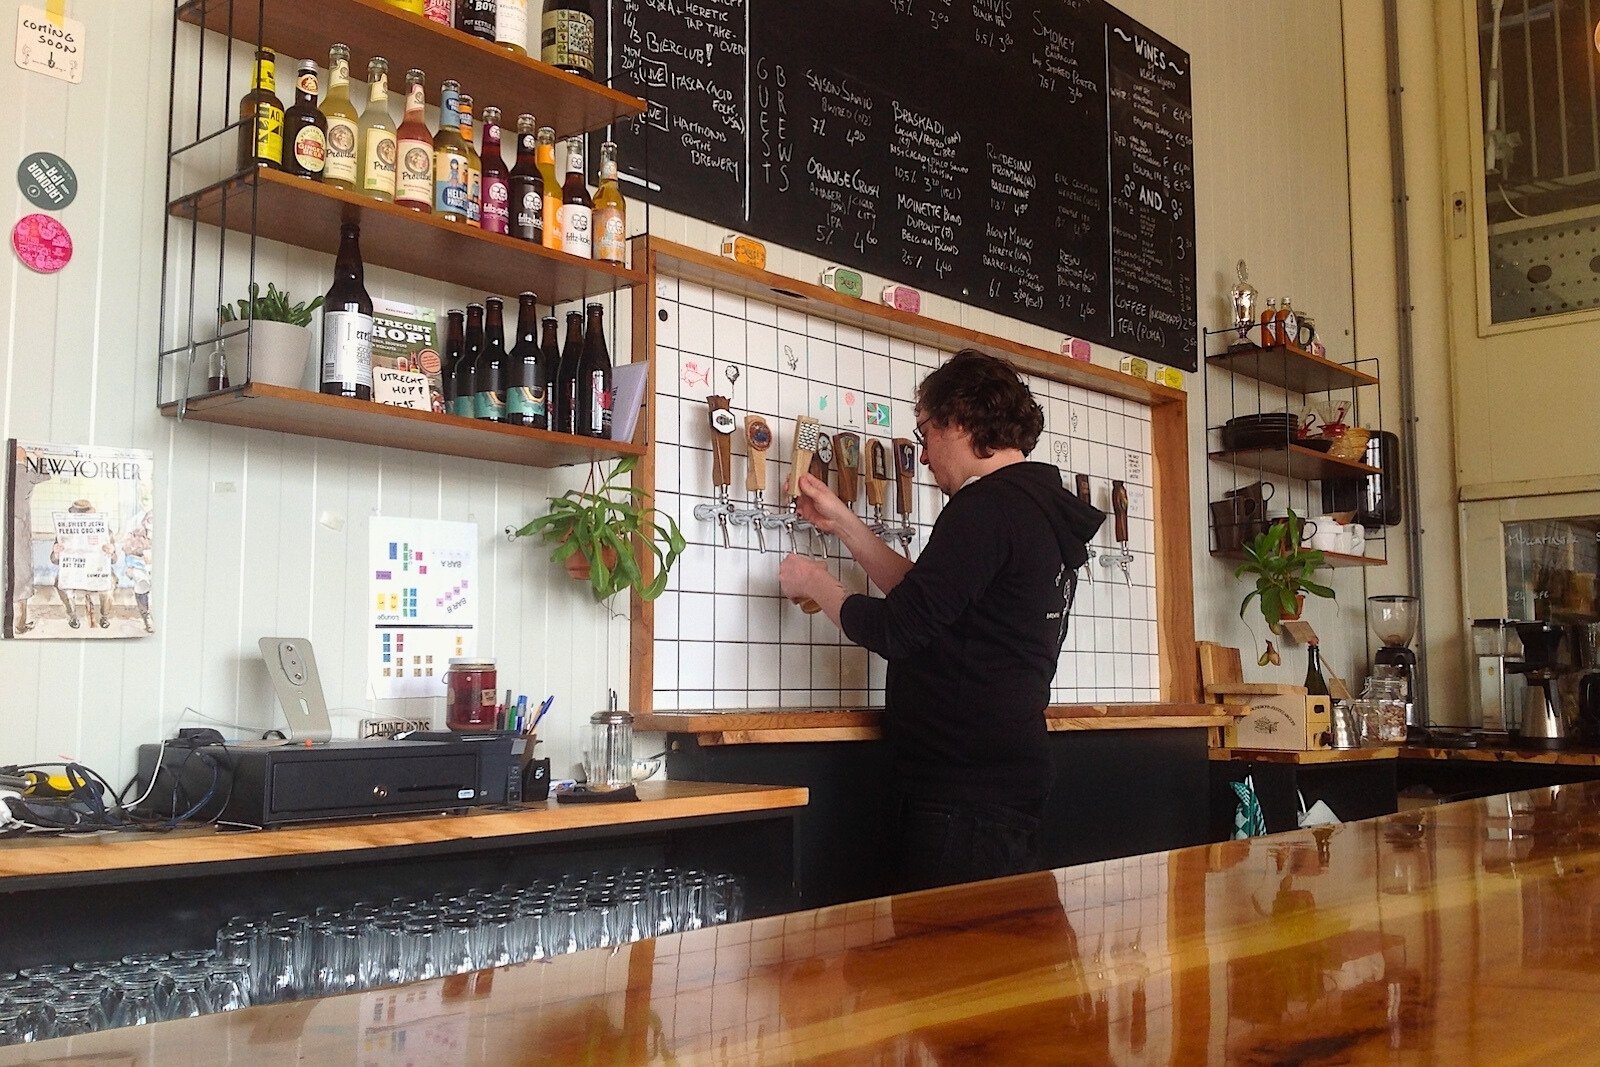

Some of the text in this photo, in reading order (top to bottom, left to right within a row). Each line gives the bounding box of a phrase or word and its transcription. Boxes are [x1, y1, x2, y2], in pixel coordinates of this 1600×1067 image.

[684, 16, 703, 30] TAP
[685, 2, 728, 22] HERETIC
[23, 19, 75, 42] COMING
[1032, 9, 1076, 54] SMOKEY
[38, 35, 77, 53] SOON
[1072, 69, 1098, 93] PORTER
[892, 100, 945, 135] BRASKADI
[45, 166, 66, 186] IPA
[691, 149, 739, 182] BREWERY
[27, 162, 64, 204] LAGONDA
[806, 156, 880, 199] ORANGE CRUSH
[1139, 184, 1163, 211] AND
[1114, 294, 1147, 317] COFFEE
[373, 325, 432, 346] HOP!
[1117, 317, 1135, 336] TEA
[380, 372, 425, 385] UTRECHT
[26, 456, 142, 481] NEW YORKER
[447, 560, 462, 568] BAR
[453, 597, 467, 610] BAR
[376, 613, 400, 621] Lounge
